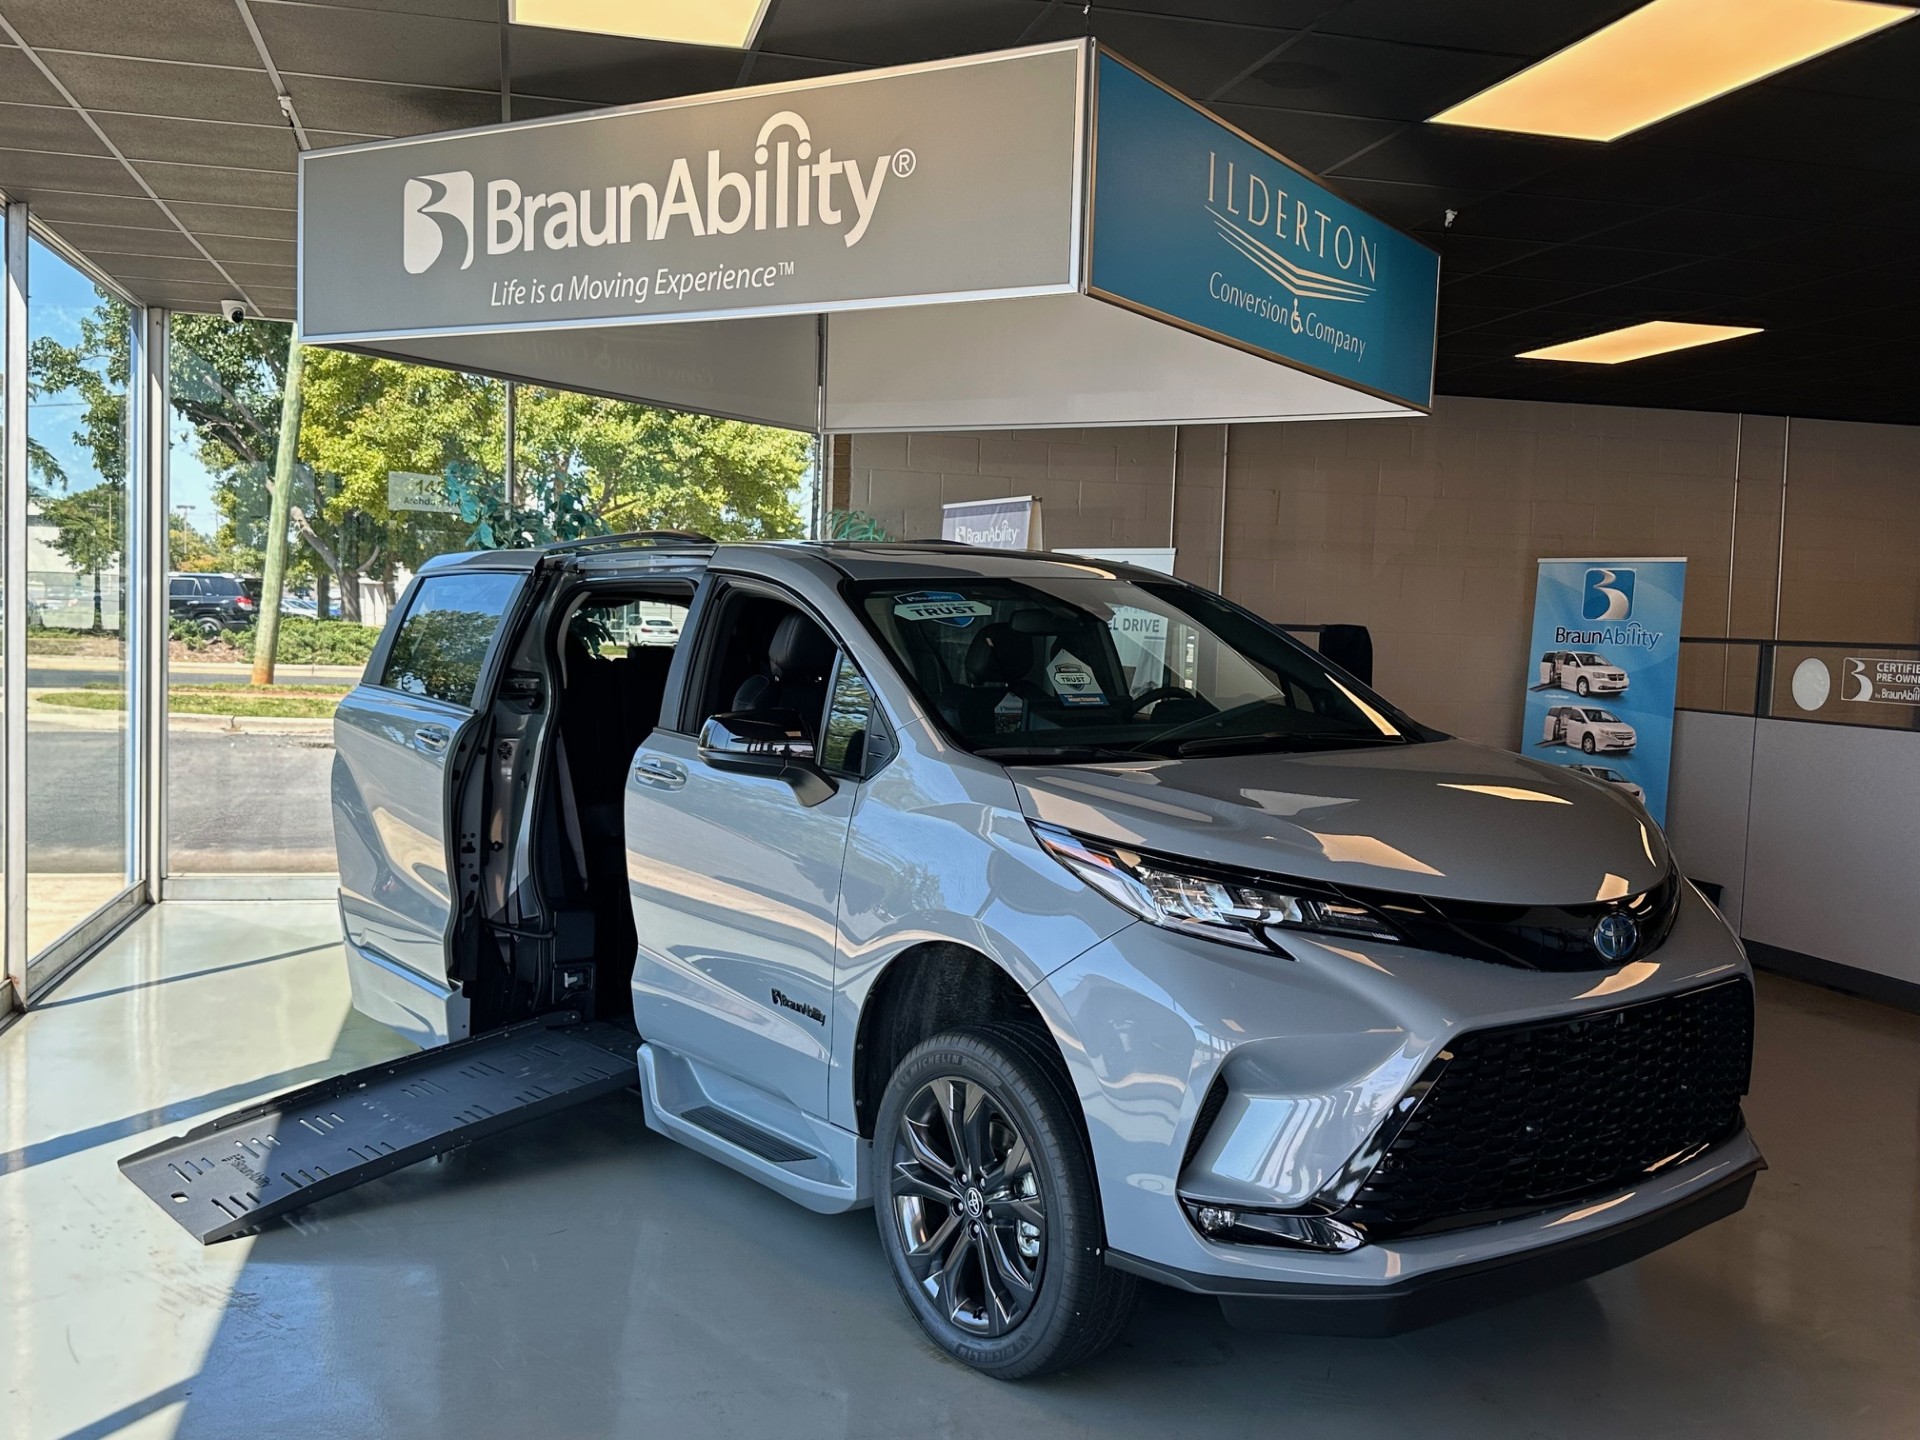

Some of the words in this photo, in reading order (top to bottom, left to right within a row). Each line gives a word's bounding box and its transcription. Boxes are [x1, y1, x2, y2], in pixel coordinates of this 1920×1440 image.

[1207, 151, 1378, 284] ILDERTON
[491, 279, 526, 306] Life
[530, 279, 546, 304] is
[550, 283, 564, 302] a
[568, 272, 650, 304] Moving
[1209, 271, 1288, 326] Conversion
[1305, 312, 1367, 363] Company
[967, 520, 1019, 545] BraunAbility
[909, 606, 977, 617] TRUST
[1122, 618, 1160, 633] DRIVE
[1555, 621, 1661, 650] BraunAbility
[910, 1053, 962, 1075] MICHELIN
